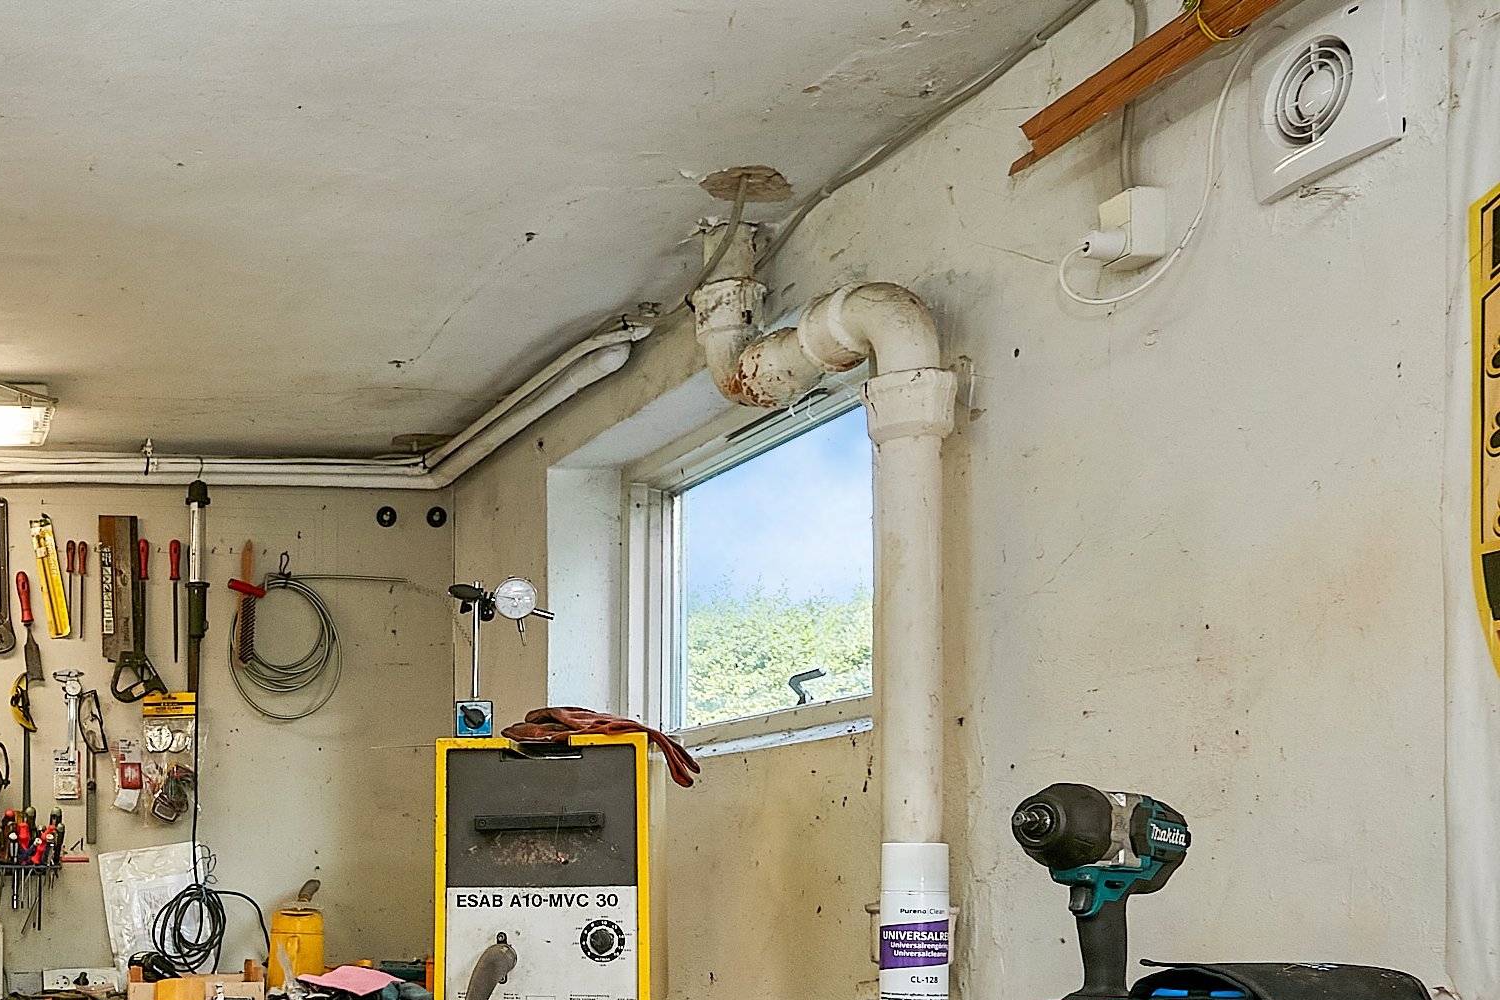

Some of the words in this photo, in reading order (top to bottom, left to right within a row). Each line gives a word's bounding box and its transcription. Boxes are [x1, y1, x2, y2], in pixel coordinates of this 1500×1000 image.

[1150, 823, 1187, 847] Makita
[457, 894, 503, 908] ESAB
[510, 894, 589, 908] A10-MVC
[596, 893, 619, 907] 30
[910, 976, 939, 984] CL-128
